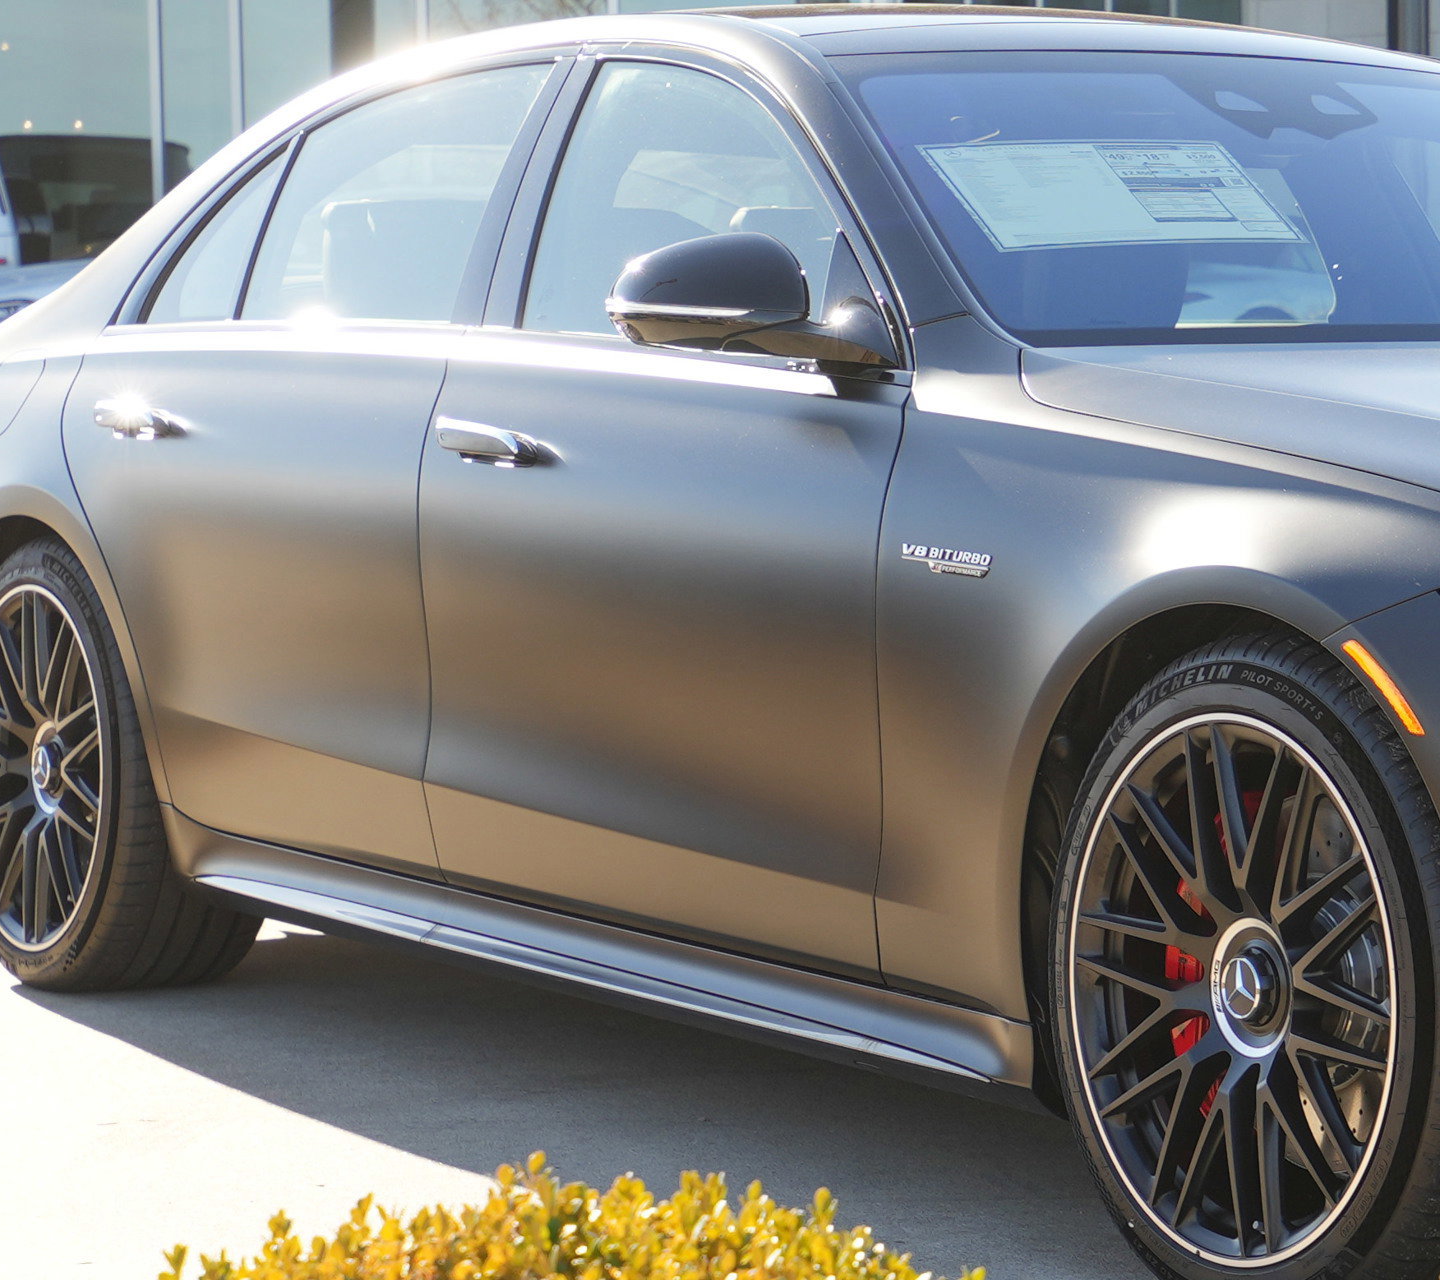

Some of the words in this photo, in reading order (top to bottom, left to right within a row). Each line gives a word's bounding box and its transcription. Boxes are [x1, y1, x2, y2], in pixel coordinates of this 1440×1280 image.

[902, 543, 928, 557] V8
[929, 547, 991, 565] BITURBO
[1135, 664, 1234, 717] MICHELIN
[1240, 669, 1273, 688] PILOT
